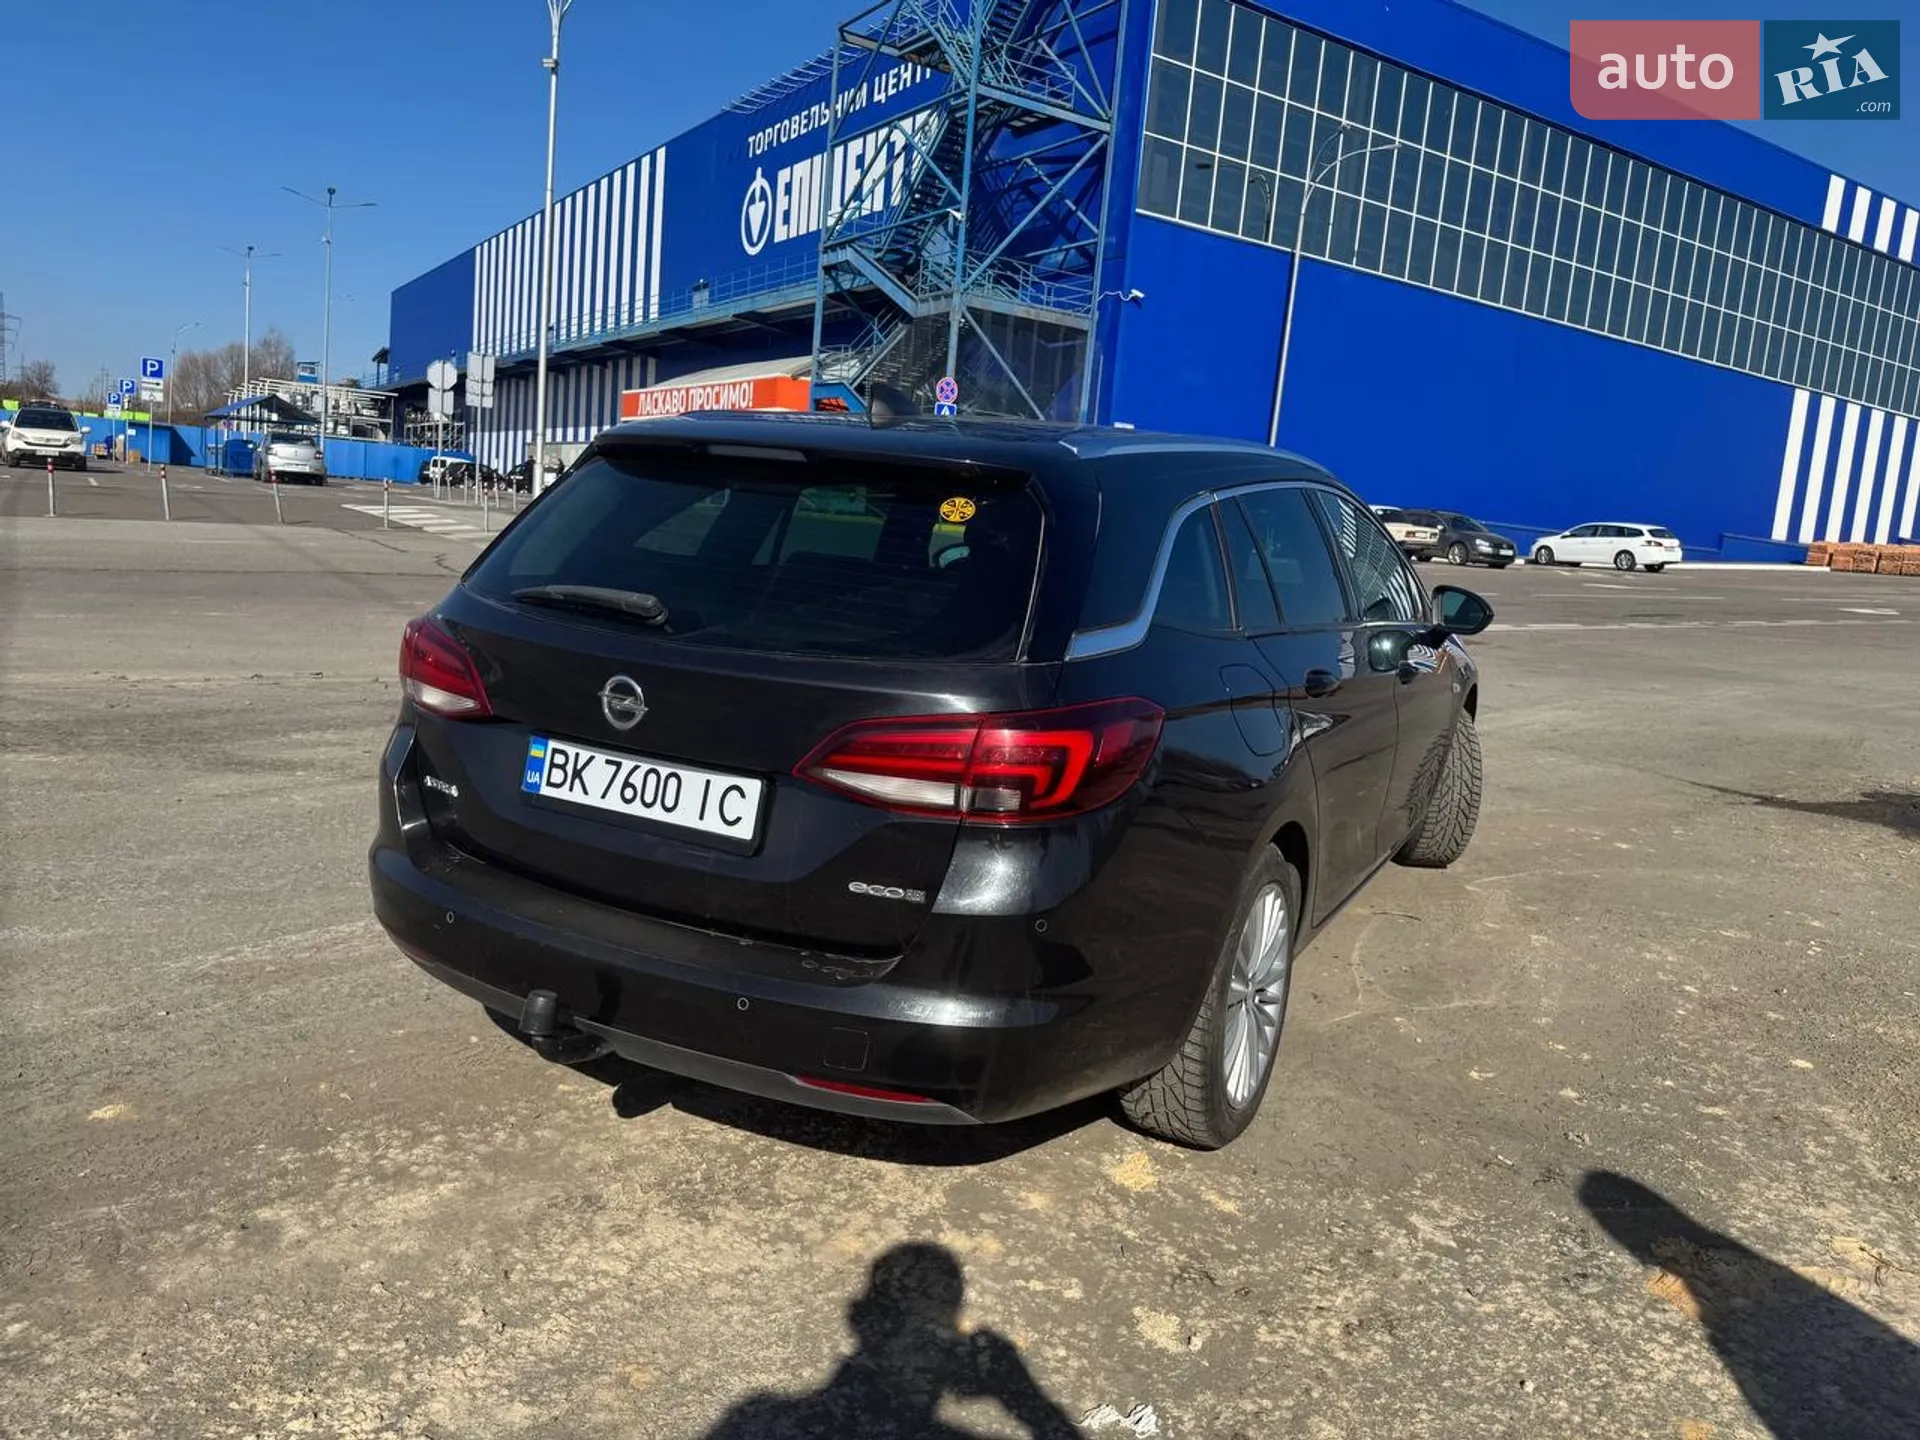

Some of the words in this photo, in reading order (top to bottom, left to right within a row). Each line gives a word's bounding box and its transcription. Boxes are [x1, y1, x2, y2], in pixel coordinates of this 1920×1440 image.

[638, 388, 686, 415] ЛАСКАВО
[688, 381, 754, 411] ПРОСИМО!
[526, 775, 540, 785] UA
[546, 747, 595, 796] BK
[600, 759, 682, 813] 7600
[698, 778, 746, 826] IC
